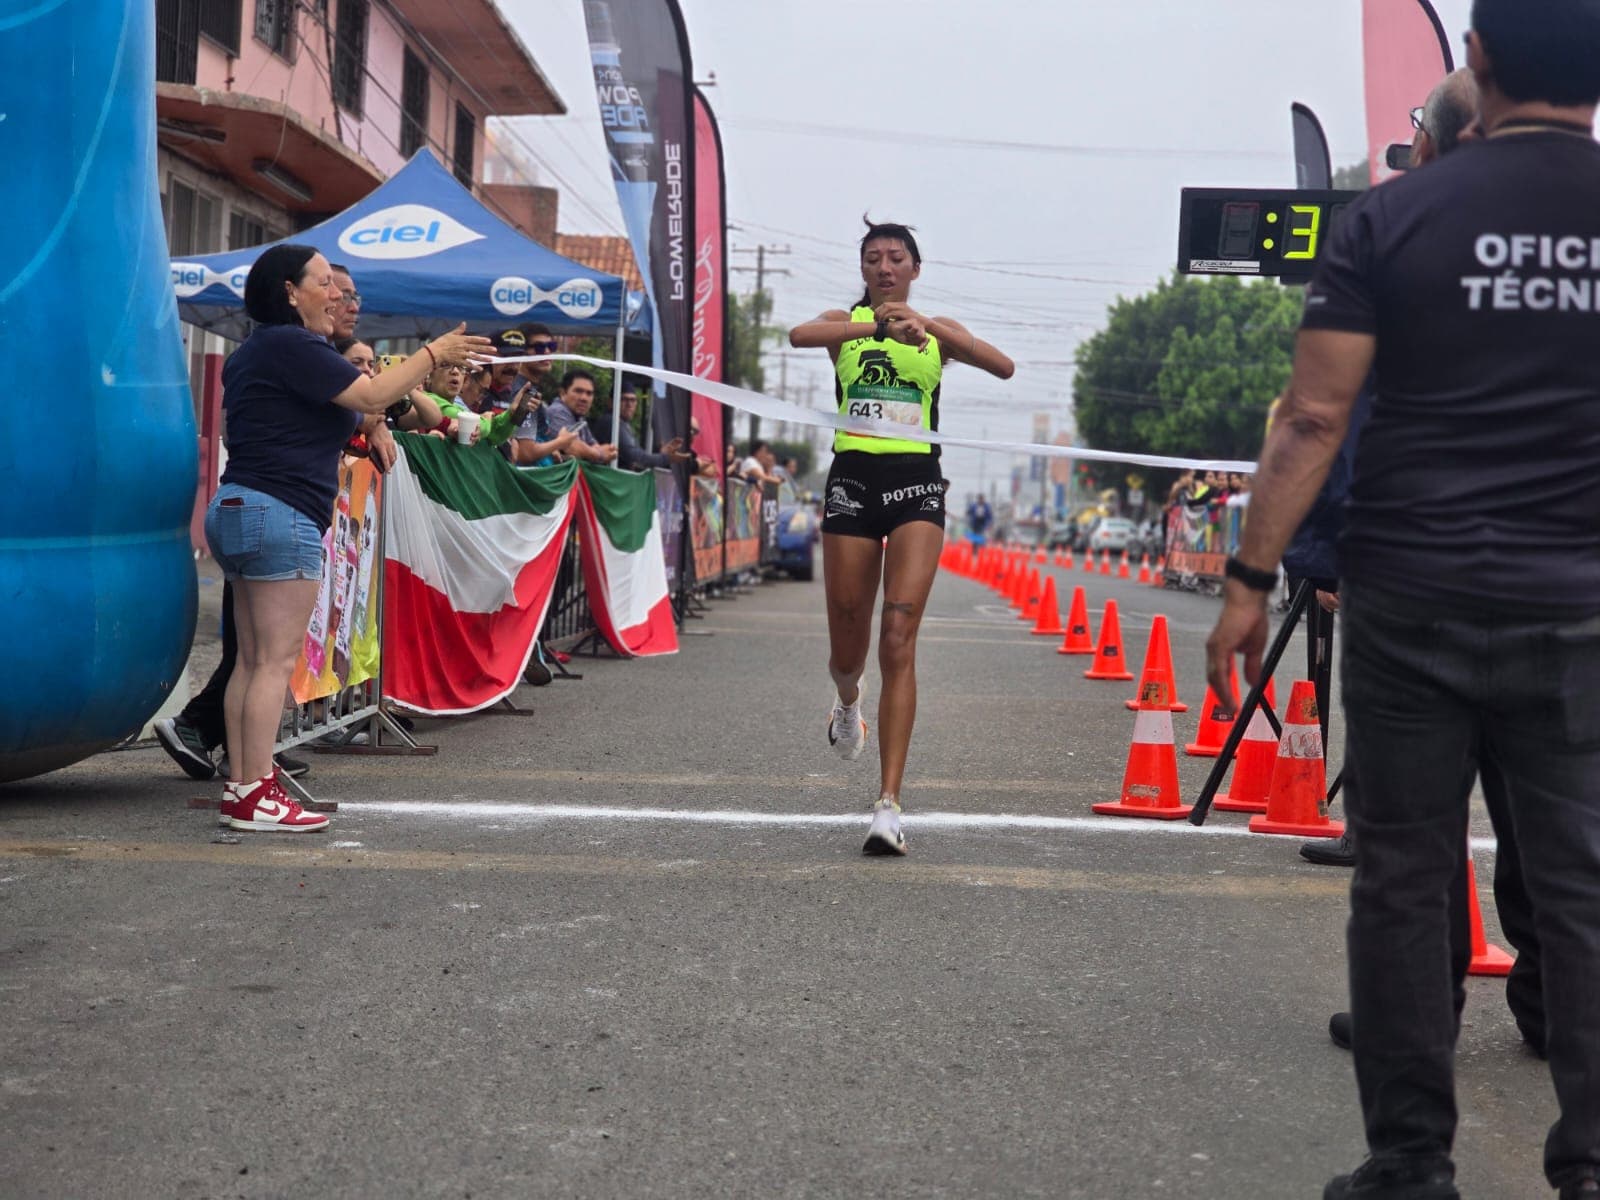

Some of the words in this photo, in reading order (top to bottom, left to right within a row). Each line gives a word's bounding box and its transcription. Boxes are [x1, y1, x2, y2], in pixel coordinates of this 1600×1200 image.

[350, 217, 441, 245] ciel
[495, 283, 533, 304] ciel
[558, 288, 597, 307] ciel
[849, 401, 883, 419] 643
[882, 483, 944, 505] POTROS
